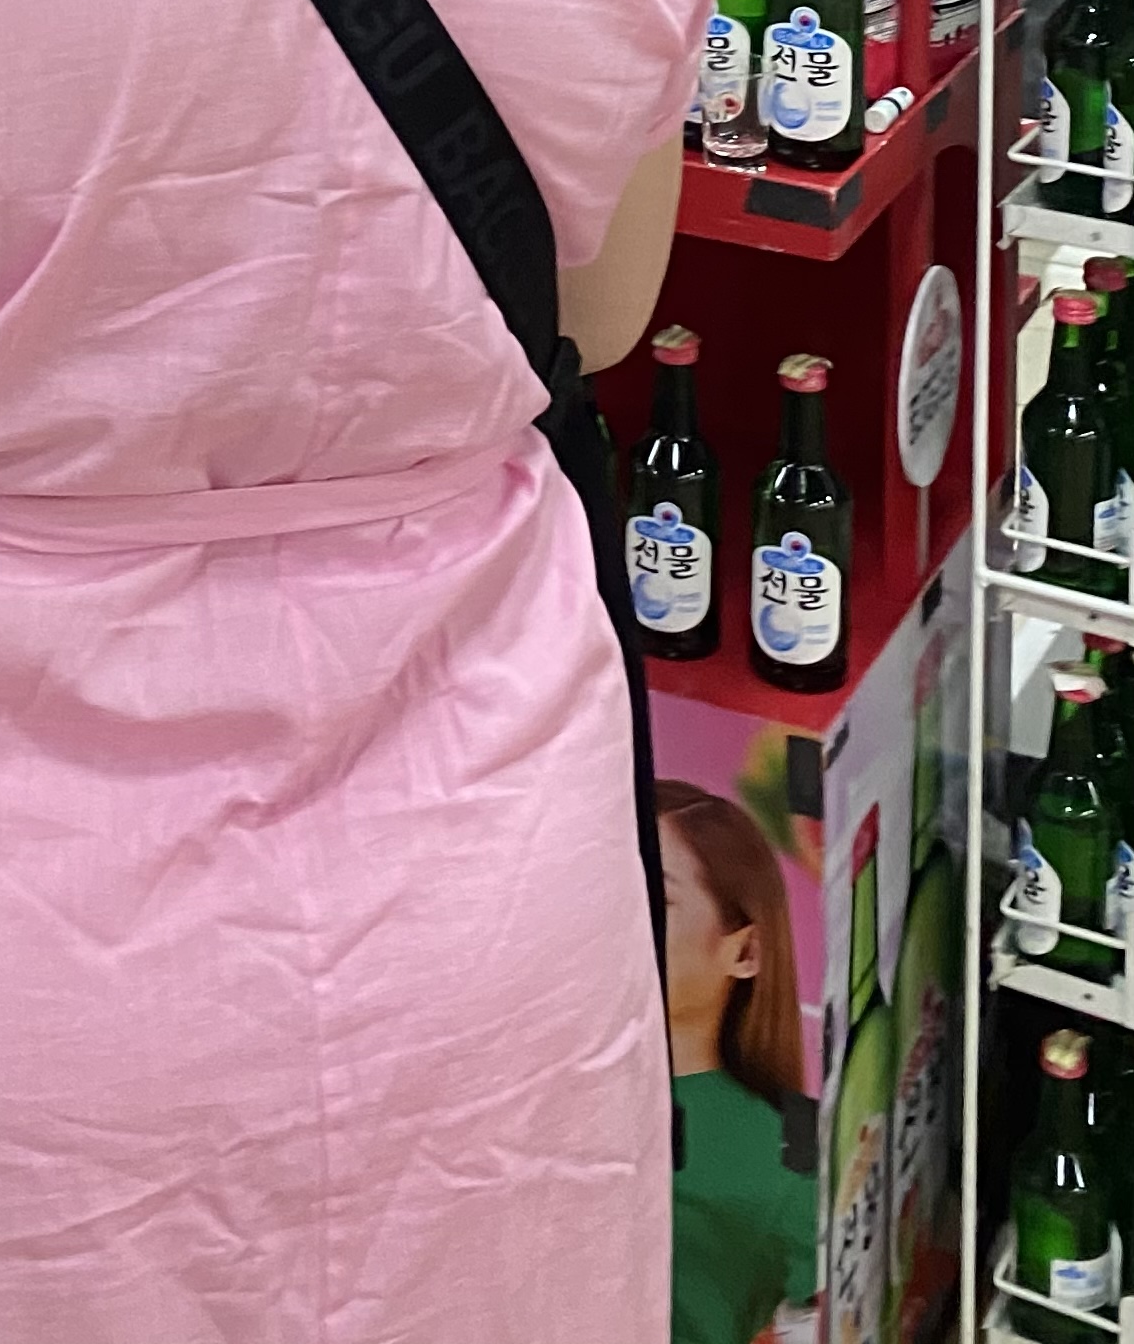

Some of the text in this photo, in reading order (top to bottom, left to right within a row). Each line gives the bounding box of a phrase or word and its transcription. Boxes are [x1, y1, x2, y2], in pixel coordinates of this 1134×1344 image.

[702, 36, 739, 72] 물
[770, 44, 841, 88] 선물
[633, 536, 701, 580] 선물
[760, 566, 831, 612] 선물
